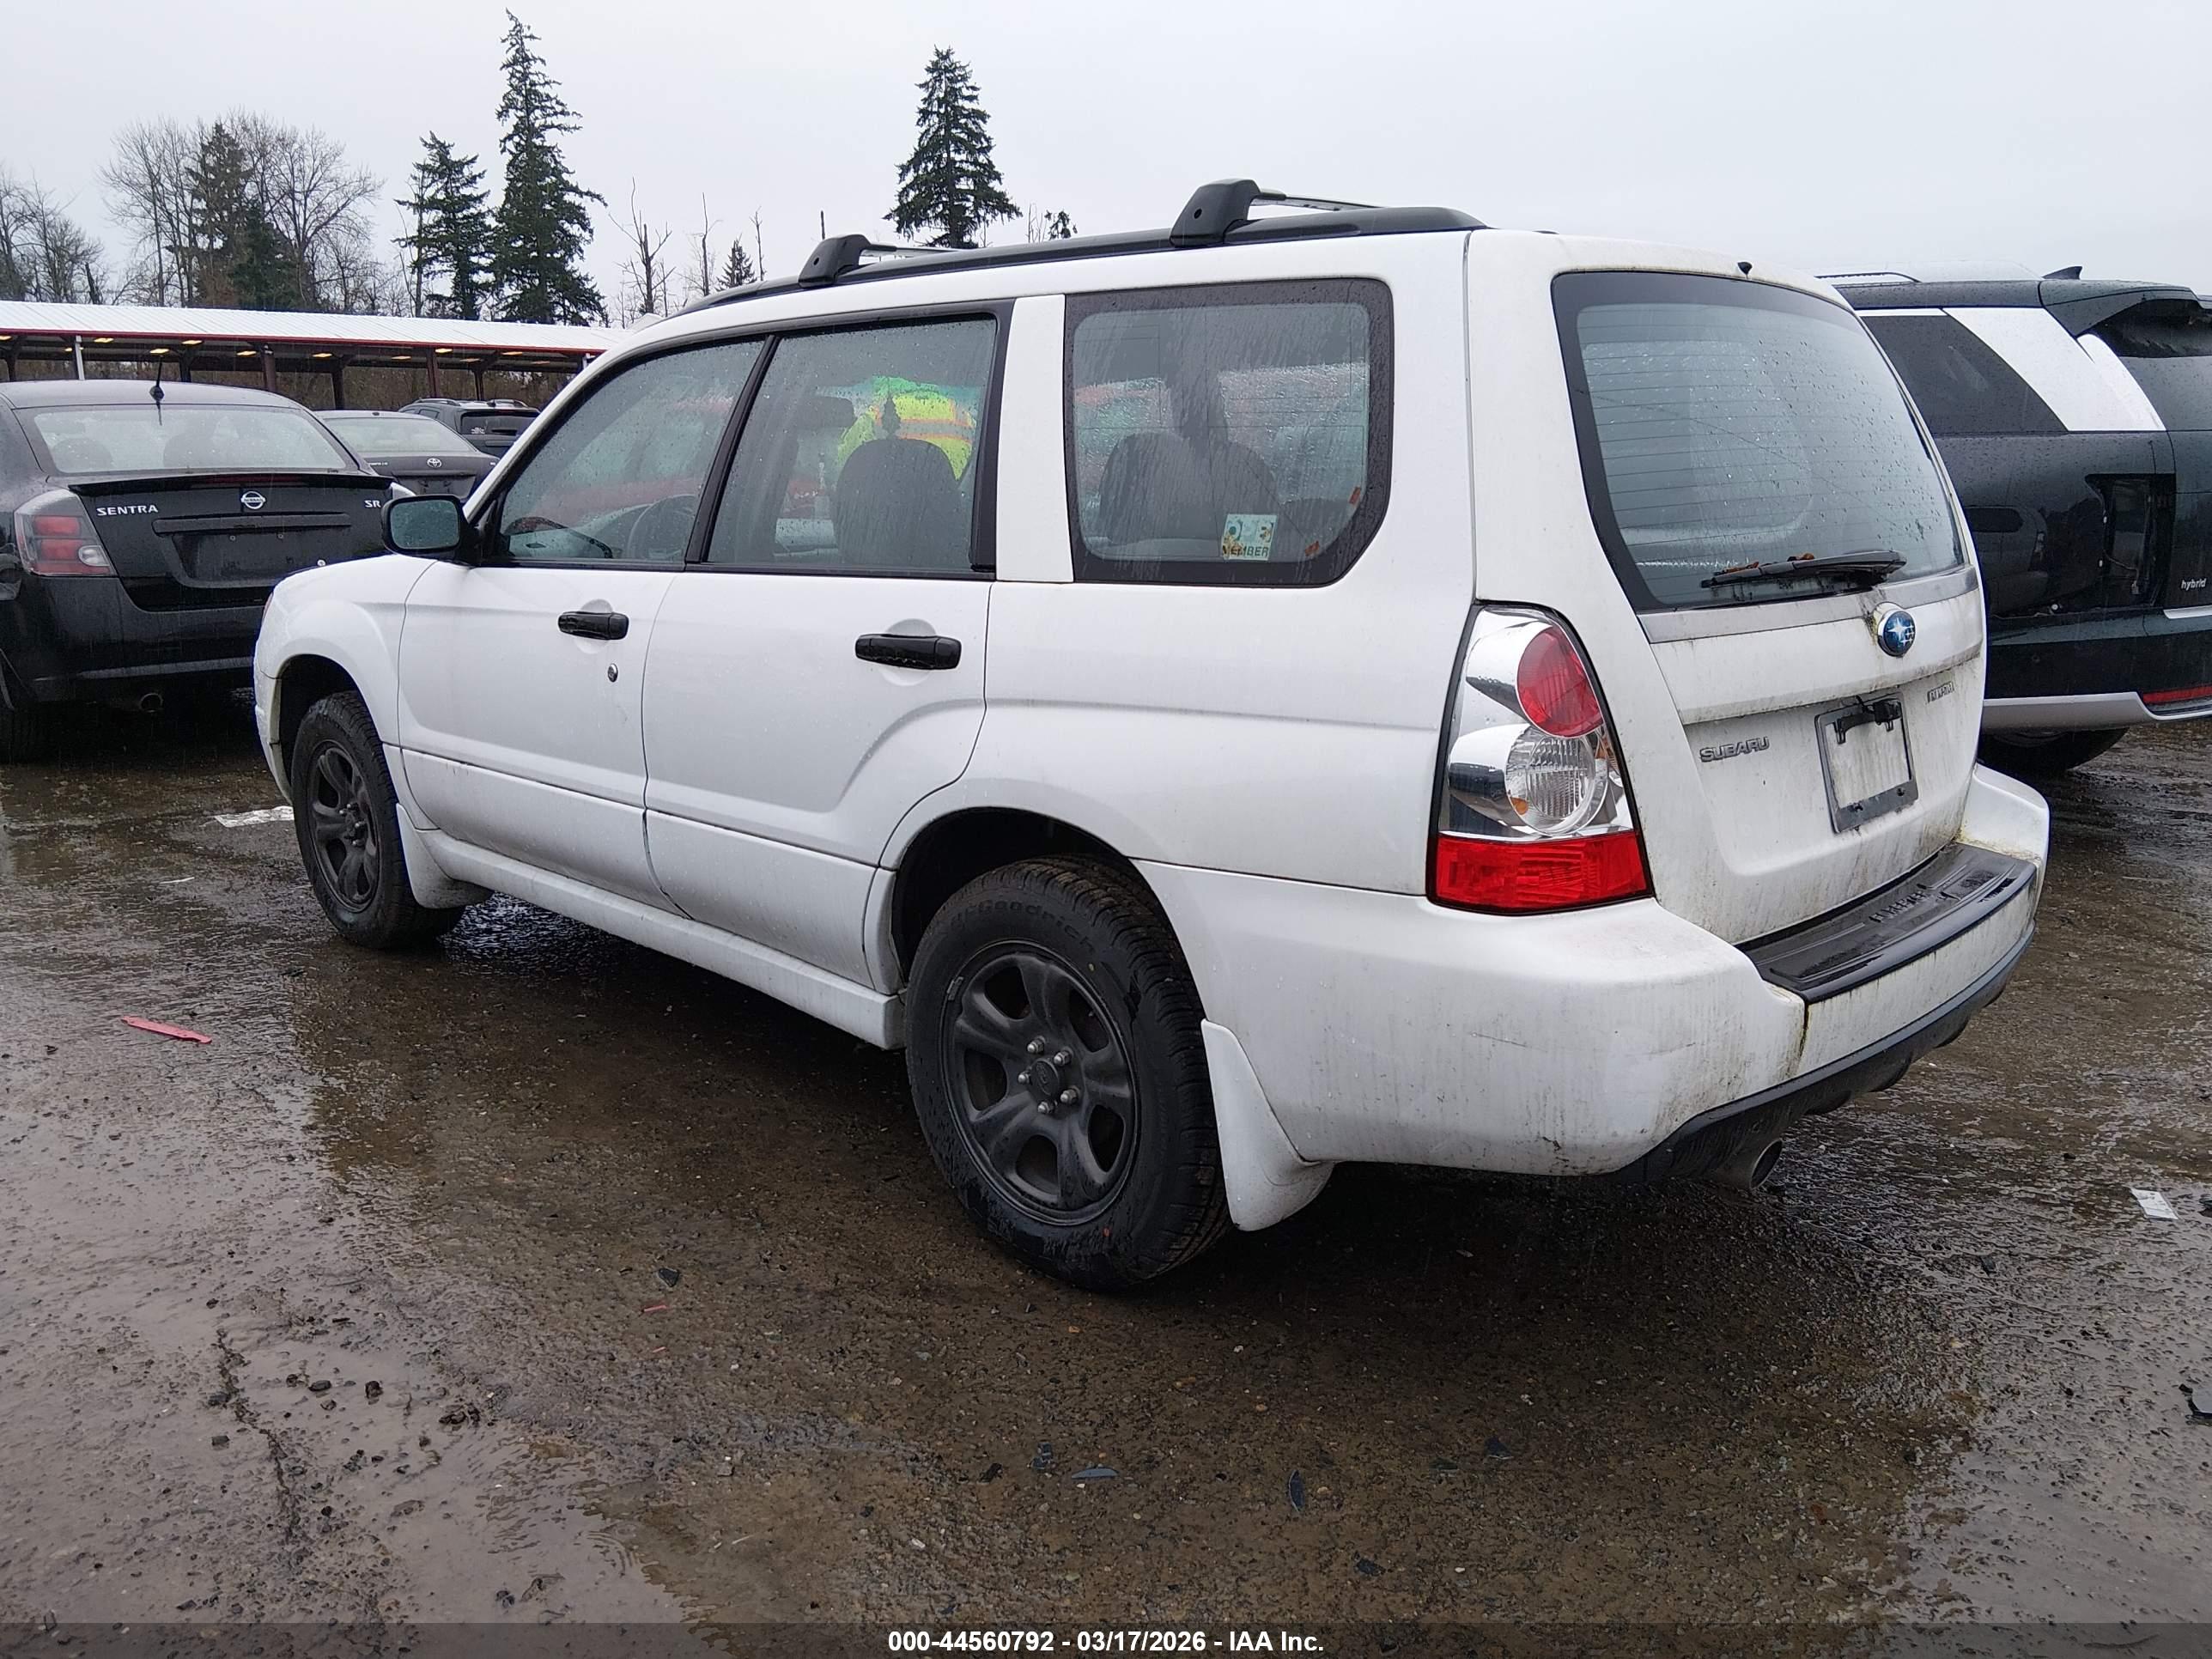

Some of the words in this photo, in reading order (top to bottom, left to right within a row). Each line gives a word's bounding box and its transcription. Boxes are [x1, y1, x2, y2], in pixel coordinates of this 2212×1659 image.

[96, 504, 159, 516] SENTRA
[364, 500, 381, 508] SR
[2180, 578, 2207, 591] hybrid
[1699, 737, 1770, 763] SUBARU
